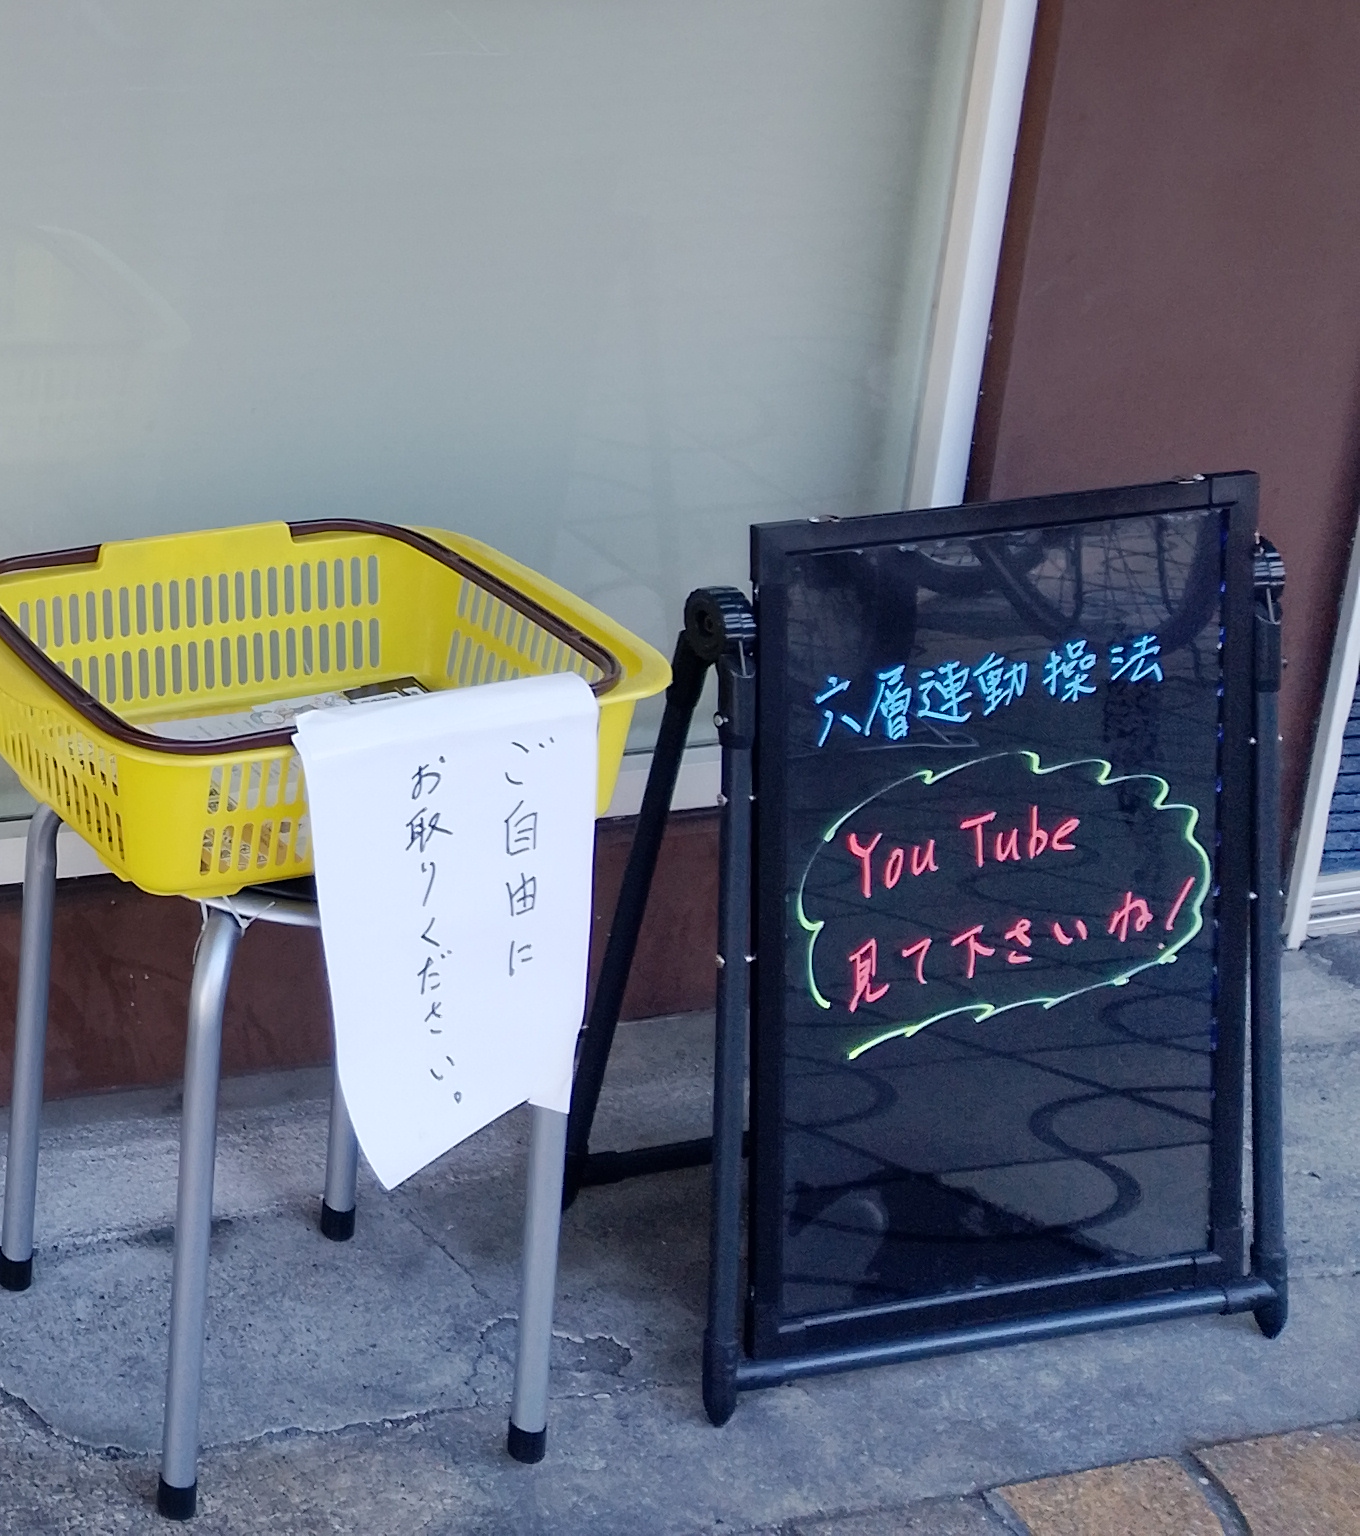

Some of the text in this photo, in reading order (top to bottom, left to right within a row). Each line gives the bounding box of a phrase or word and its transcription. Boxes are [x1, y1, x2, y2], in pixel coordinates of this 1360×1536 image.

[813, 635, 1164, 748] 六層連動操法
[404, 754, 464, 1105] お取りください。
[503, 736, 556, 978] ご自由に
[847, 805, 1081, 899] You Tube
